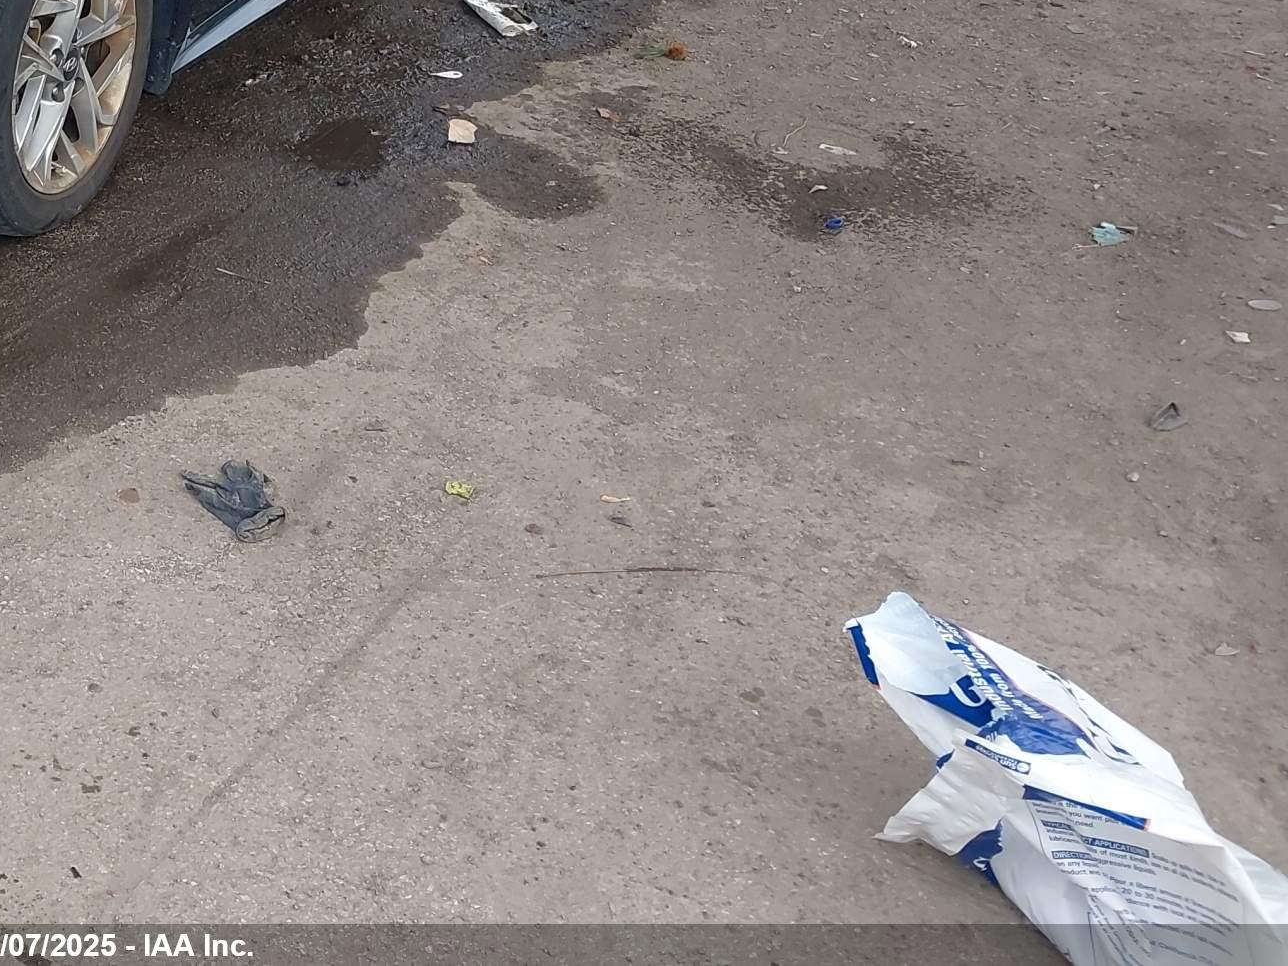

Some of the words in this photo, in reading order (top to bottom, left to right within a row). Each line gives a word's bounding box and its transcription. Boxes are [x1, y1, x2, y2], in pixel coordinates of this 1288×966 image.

[951, 648, 1015, 712] Industrial
[988, 672, 1016, 699] from
[1011, 698, 1045, 719] Made
